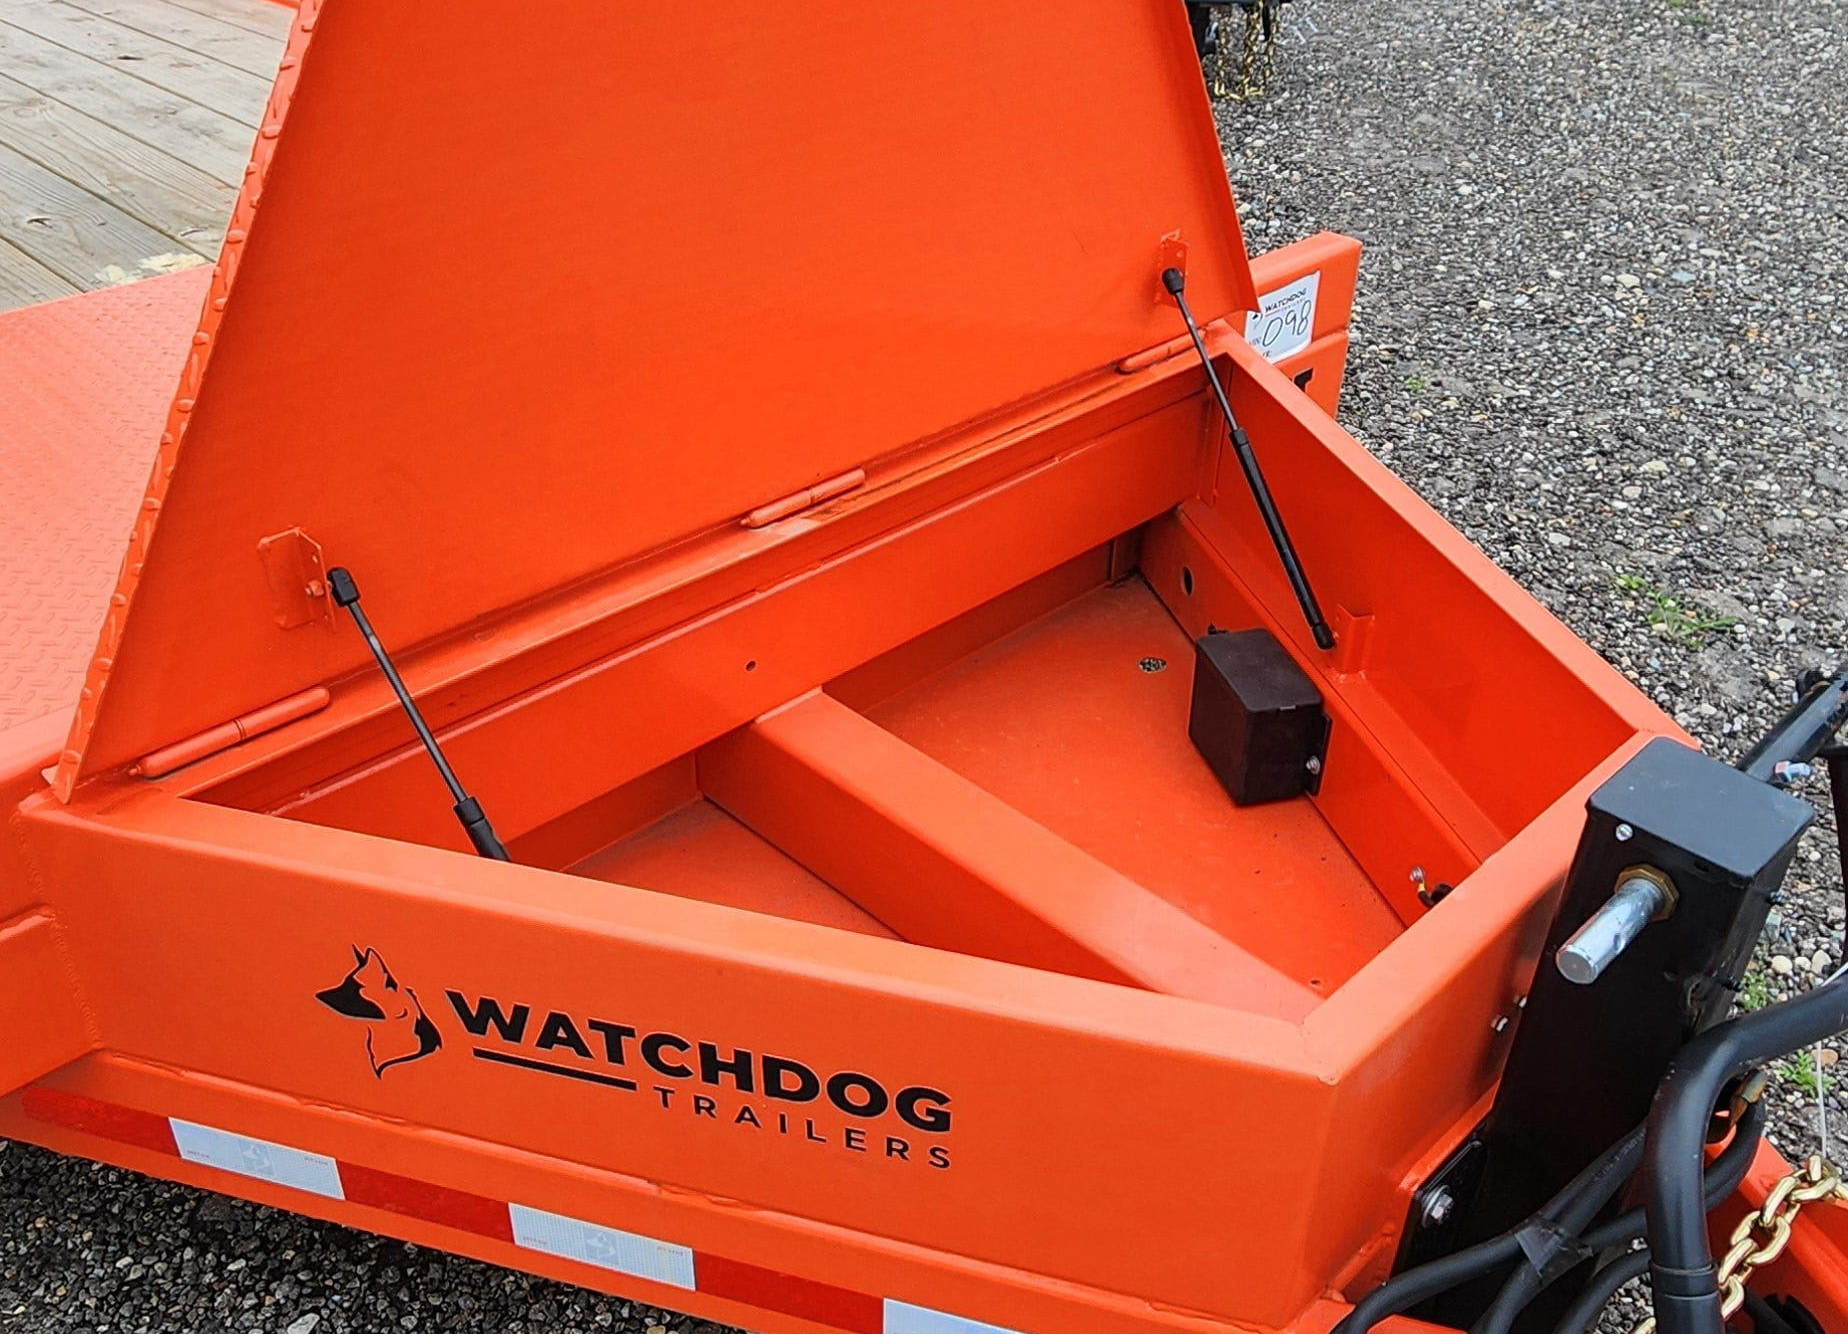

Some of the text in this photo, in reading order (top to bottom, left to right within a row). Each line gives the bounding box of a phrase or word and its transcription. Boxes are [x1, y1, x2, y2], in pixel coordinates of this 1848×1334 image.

[1262, 300, 1312, 348] 098
[1264, 287, 1307, 313] WATCHDOG
[445, 990, 953, 1134] WATCHDOG
[654, 1086, 951, 1170] TRAILERS
